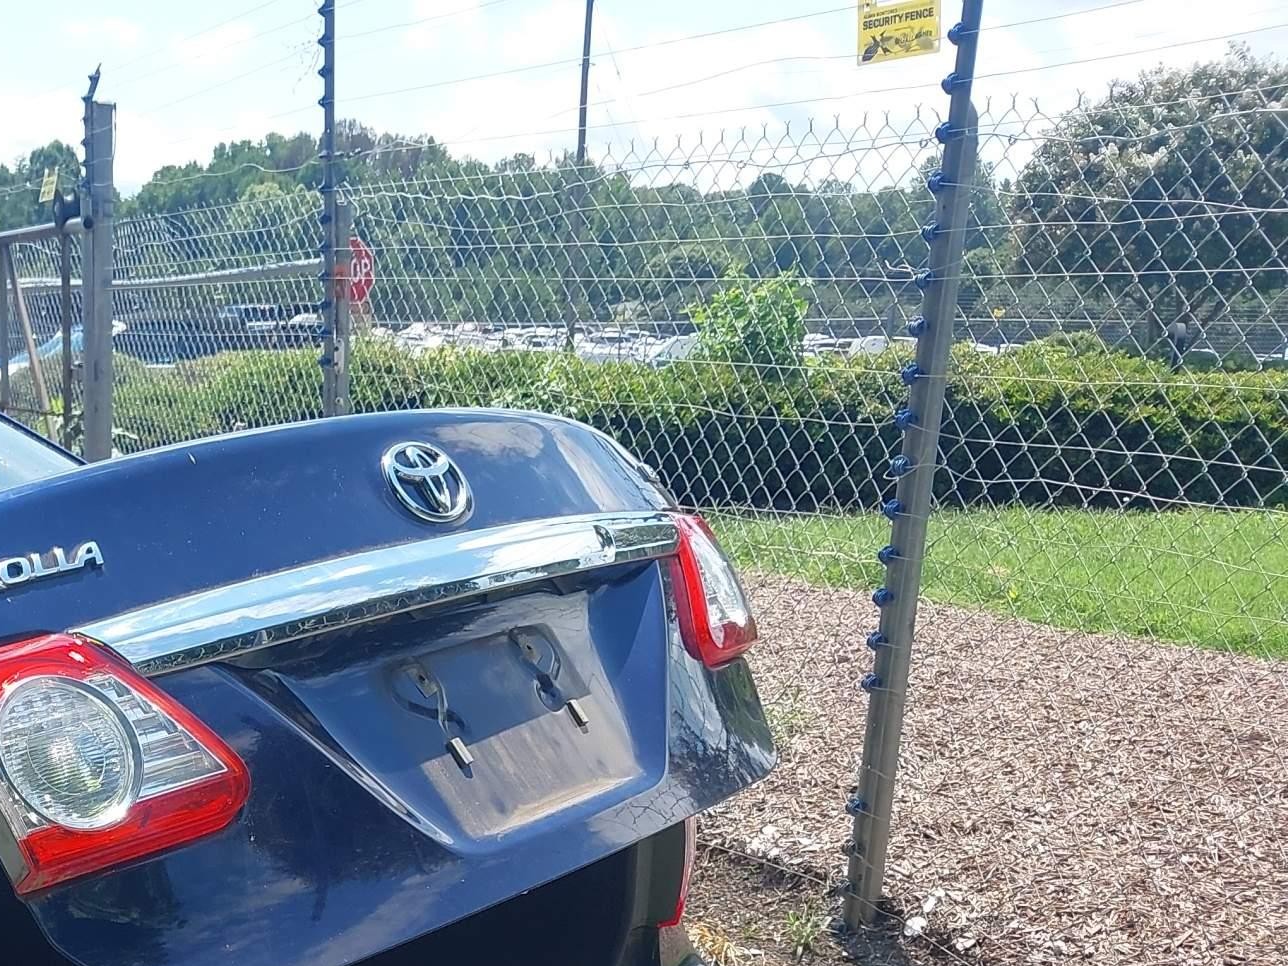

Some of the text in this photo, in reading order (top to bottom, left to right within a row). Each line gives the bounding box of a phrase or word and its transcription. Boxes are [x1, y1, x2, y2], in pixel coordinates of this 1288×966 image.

[863, 7, 934, 31] SECURITY FENCE
[350, 258, 370, 284] OP
